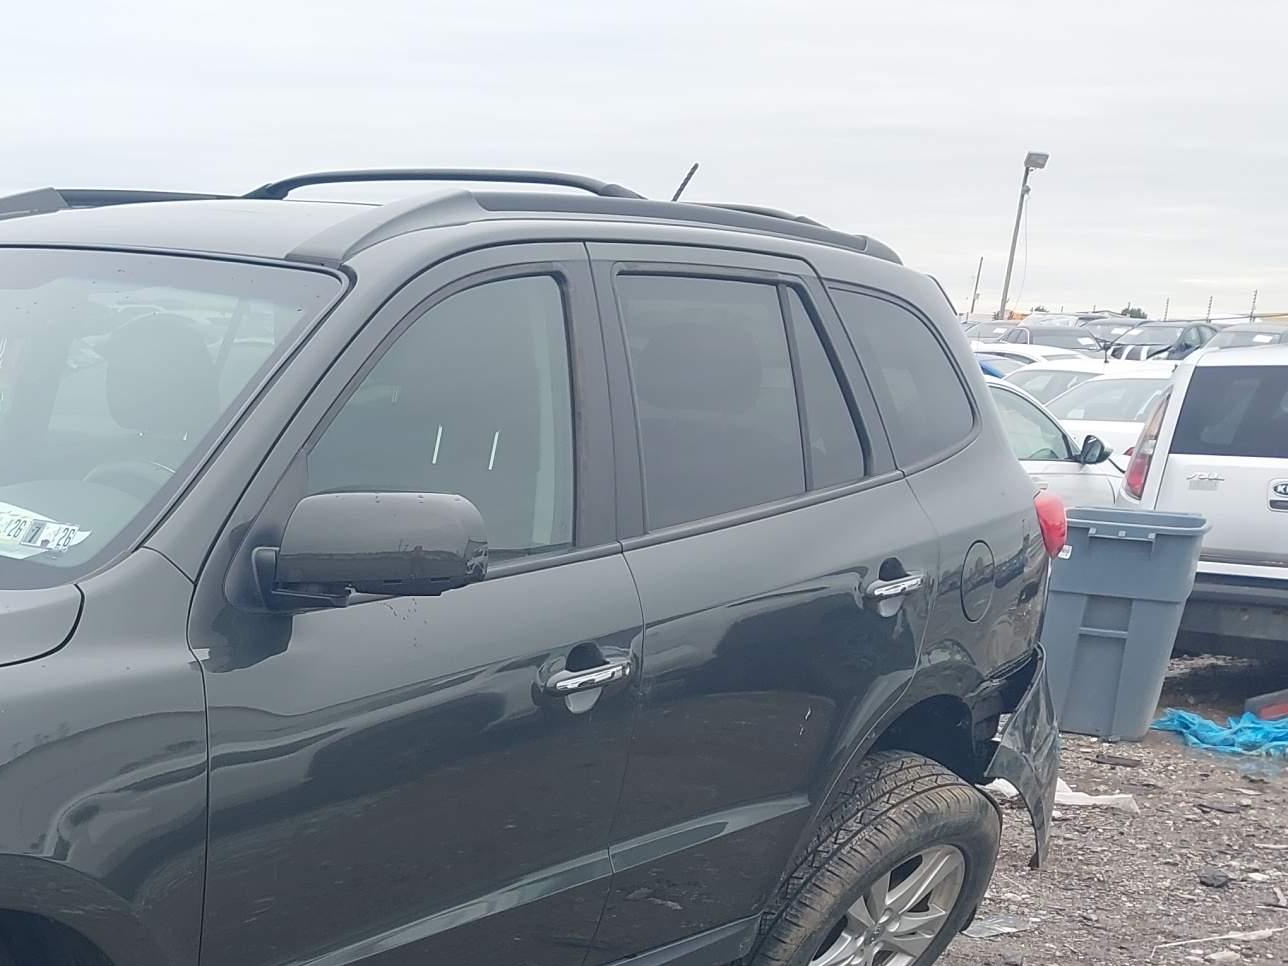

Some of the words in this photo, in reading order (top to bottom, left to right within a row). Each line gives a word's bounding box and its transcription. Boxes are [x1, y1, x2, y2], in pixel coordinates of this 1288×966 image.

[7, 518, 27, 538] 26
[28, 526, 42, 543] 7
[55, 527, 76, 547] 26
